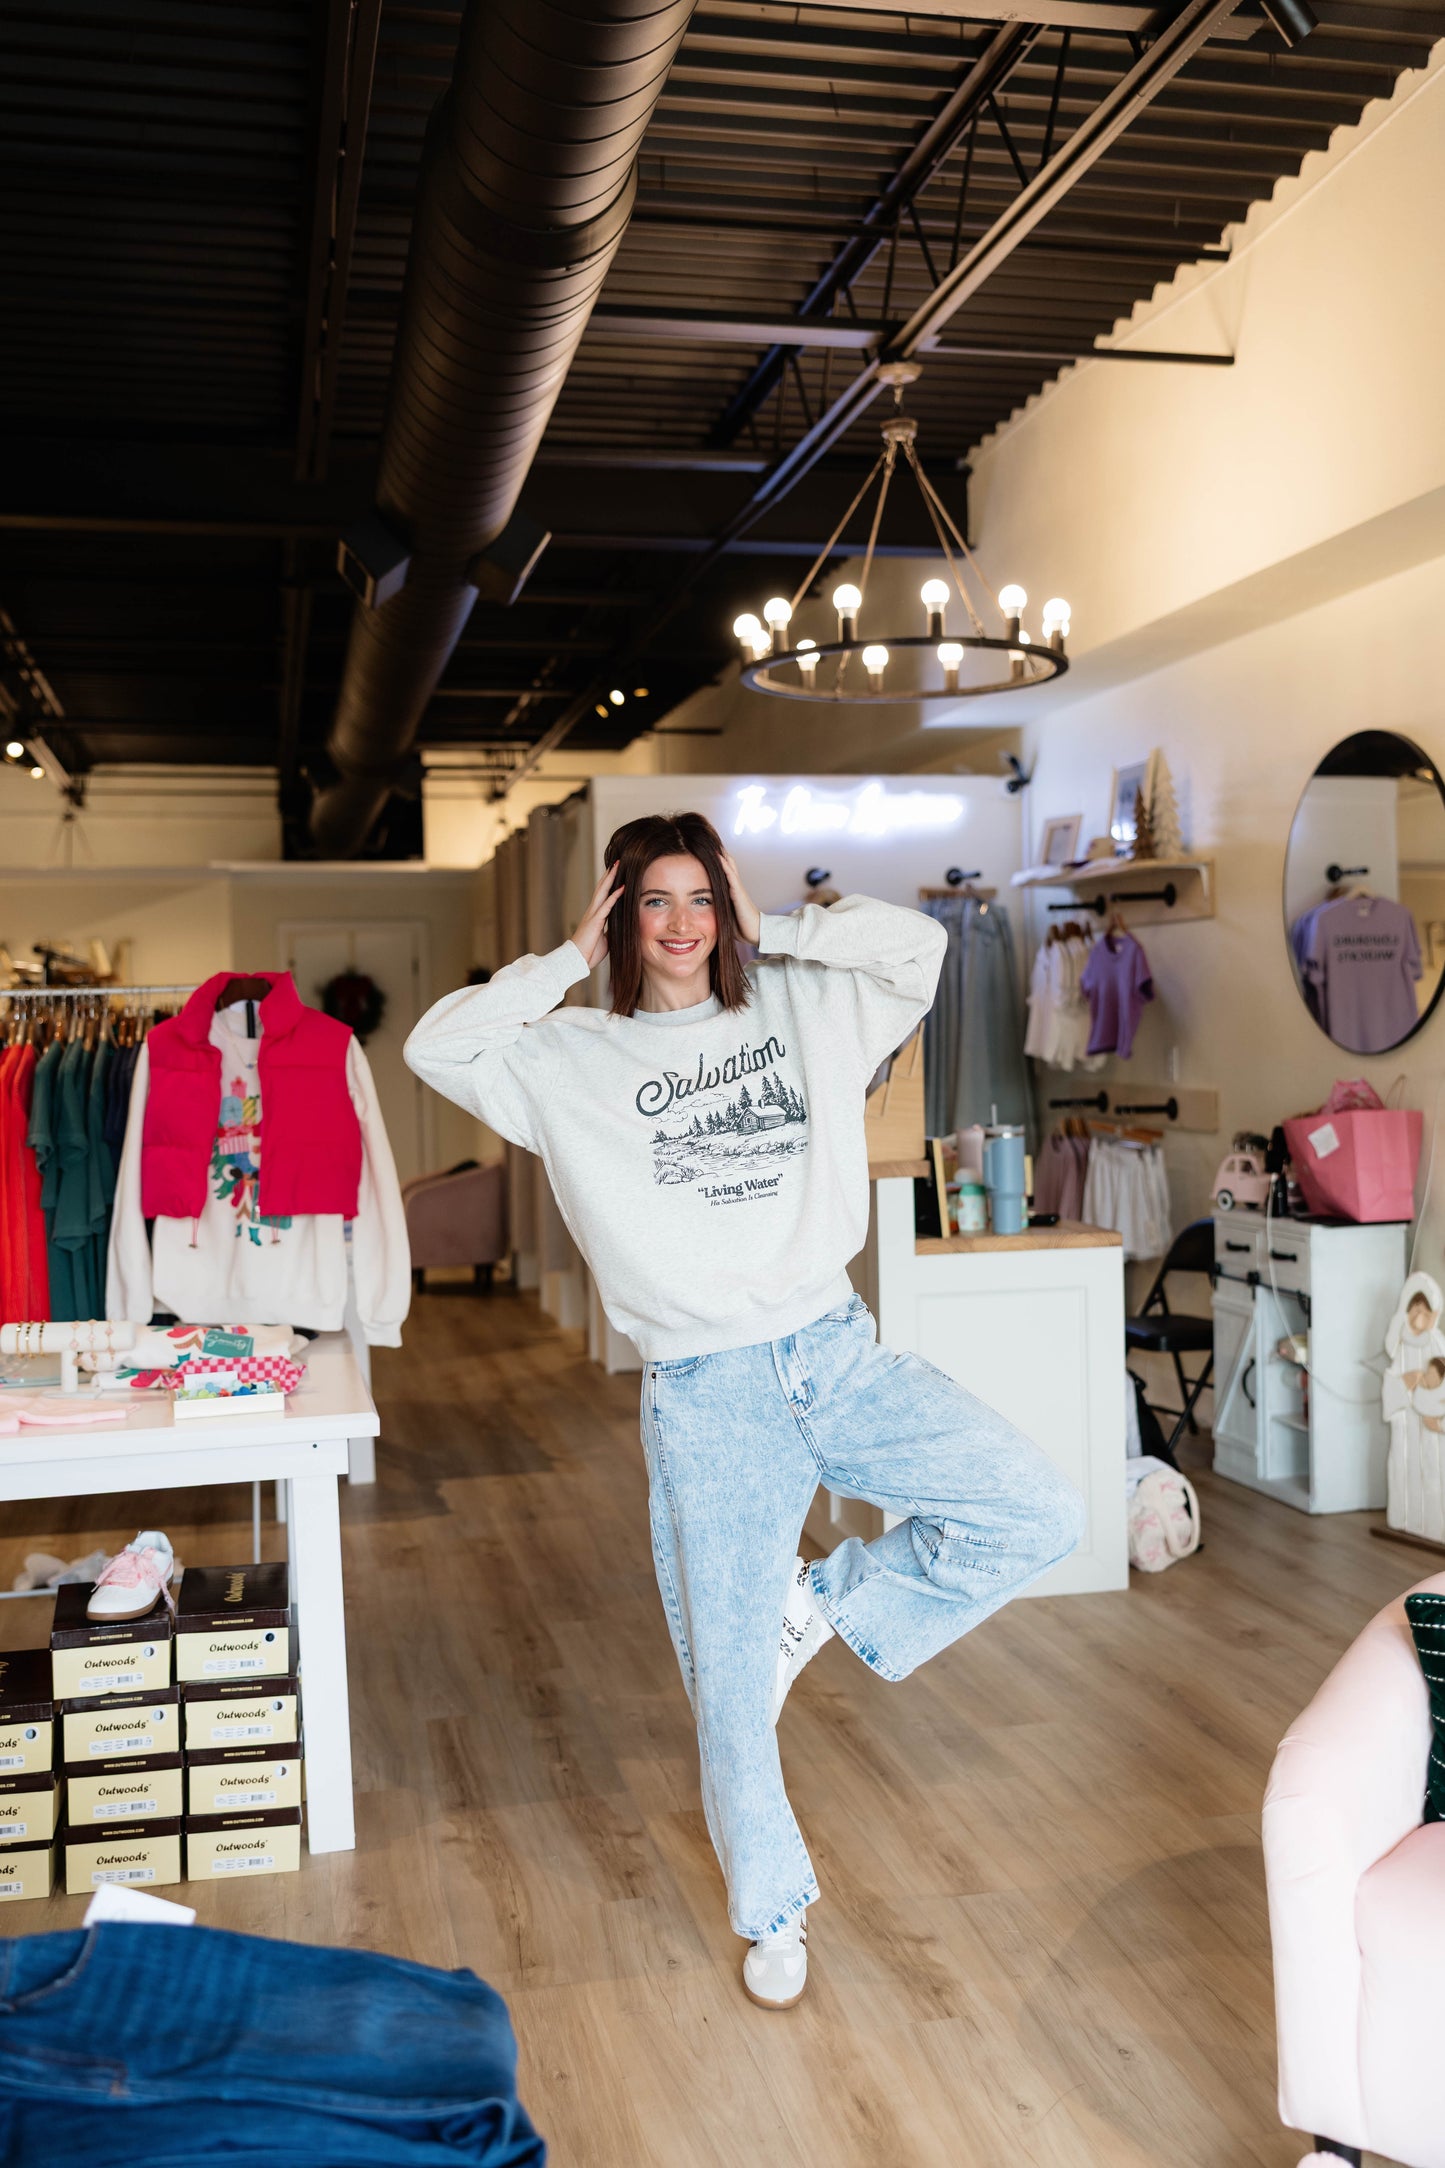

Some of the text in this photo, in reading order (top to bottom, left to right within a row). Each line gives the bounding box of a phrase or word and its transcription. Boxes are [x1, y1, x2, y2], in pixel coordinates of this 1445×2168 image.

[636, 1036, 786, 1117] Salvation
[697, 1172, 784, 1199] “Living Water”
[209, 1641, 259, 1653] Outwoods
[84, 1656, 136, 1669] Outwoods
[216, 1708, 267, 1720] Outwoods
[95, 1719, 147, 1733] Outwoods
[220, 1774, 270, 1787] Outwoods
[98, 1783, 150, 1796] Outwoods
[216, 1839, 266, 1853] Outwoods
[96, 1851, 148, 1865] Outwoods
